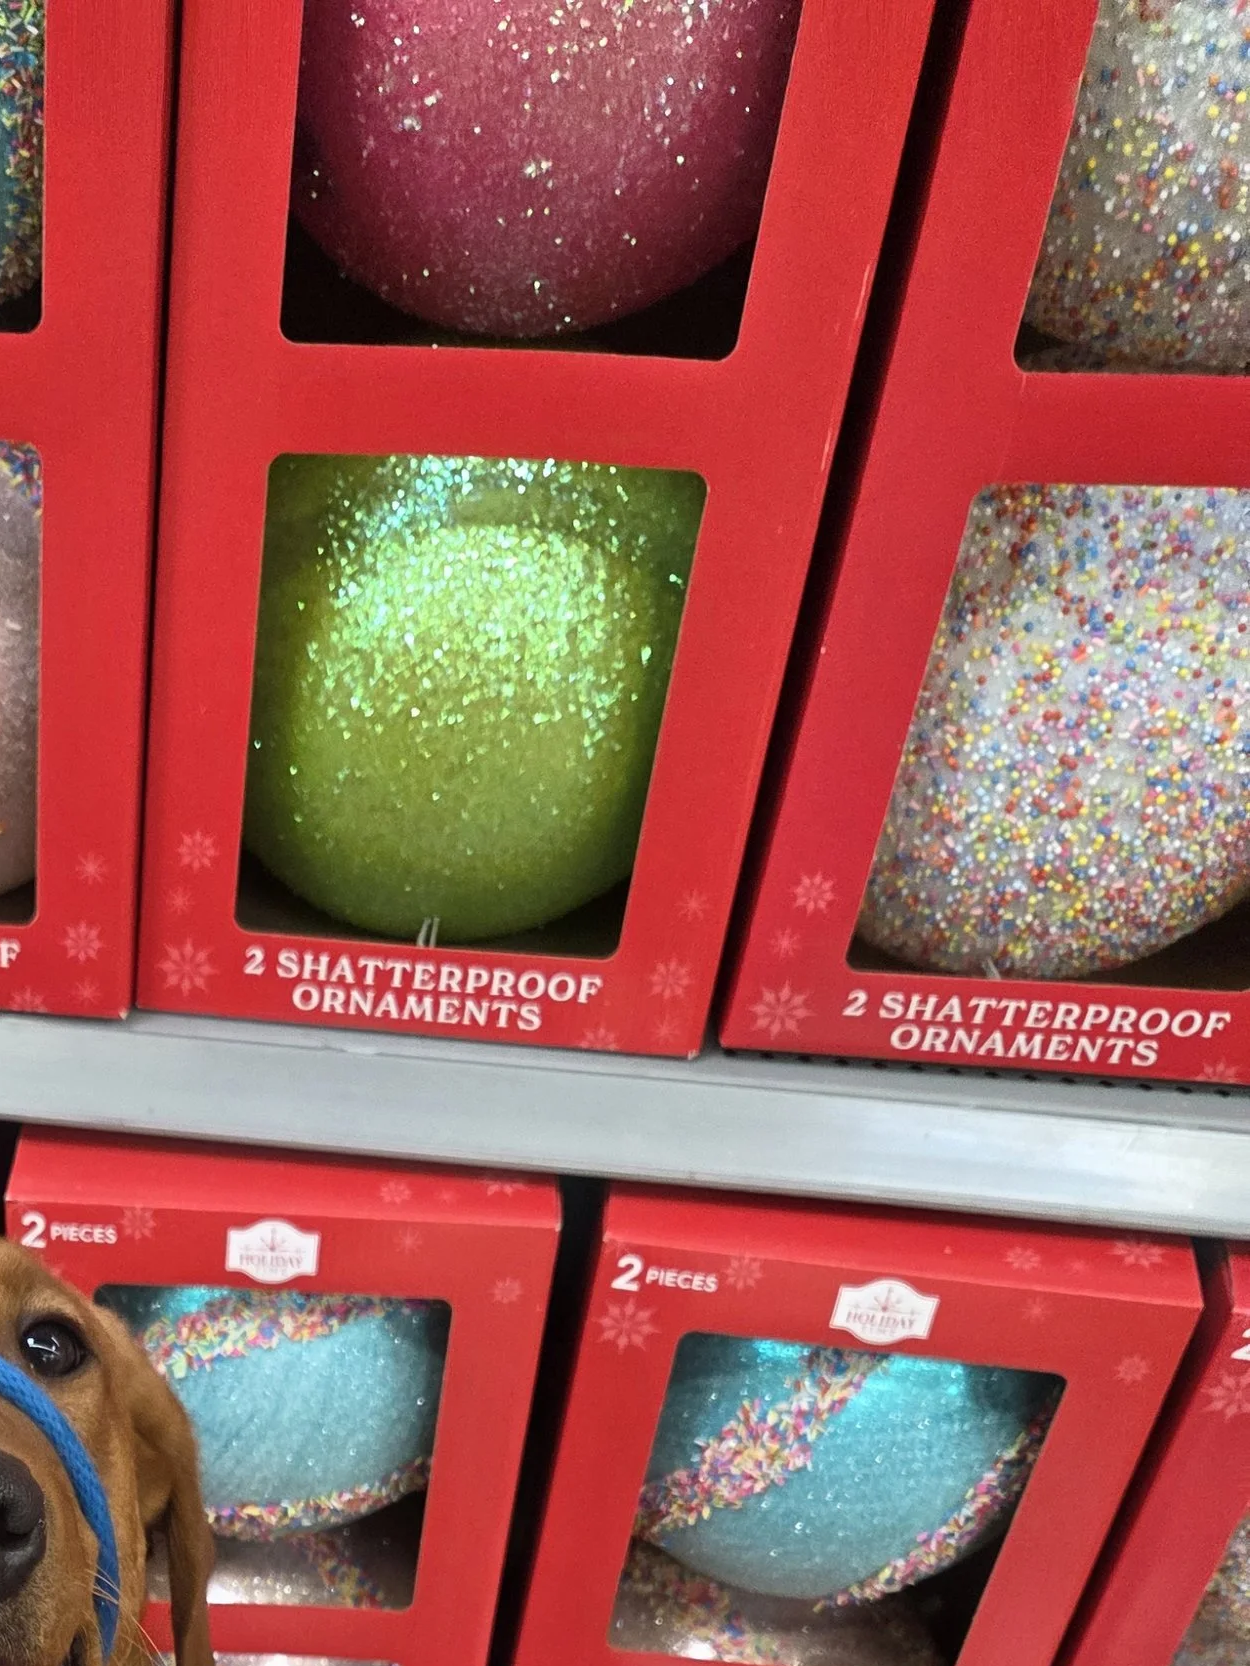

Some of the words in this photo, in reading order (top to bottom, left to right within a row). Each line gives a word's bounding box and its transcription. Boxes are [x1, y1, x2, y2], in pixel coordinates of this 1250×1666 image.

[243, 945, 265, 975] 2
[276, 948, 603, 1004] SHATTERPROOF
[292, 983, 542, 1032] ORNAMENTS
[842, 989, 869, 1017] 2
[878, 991, 1231, 1040] SHATTERPROOF
[890, 1023, 1159, 1067] ORNAMENTS
[21, 1211, 47, 1249] 2
[50, 1221, 118, 1245] PIECES
[238, 1253, 304, 1269] HOLIDAY
[611, 1254, 644, 1292] 2
[645, 1266, 719, 1293] PIECES
[845, 1310, 917, 1330] HOLIDAY
